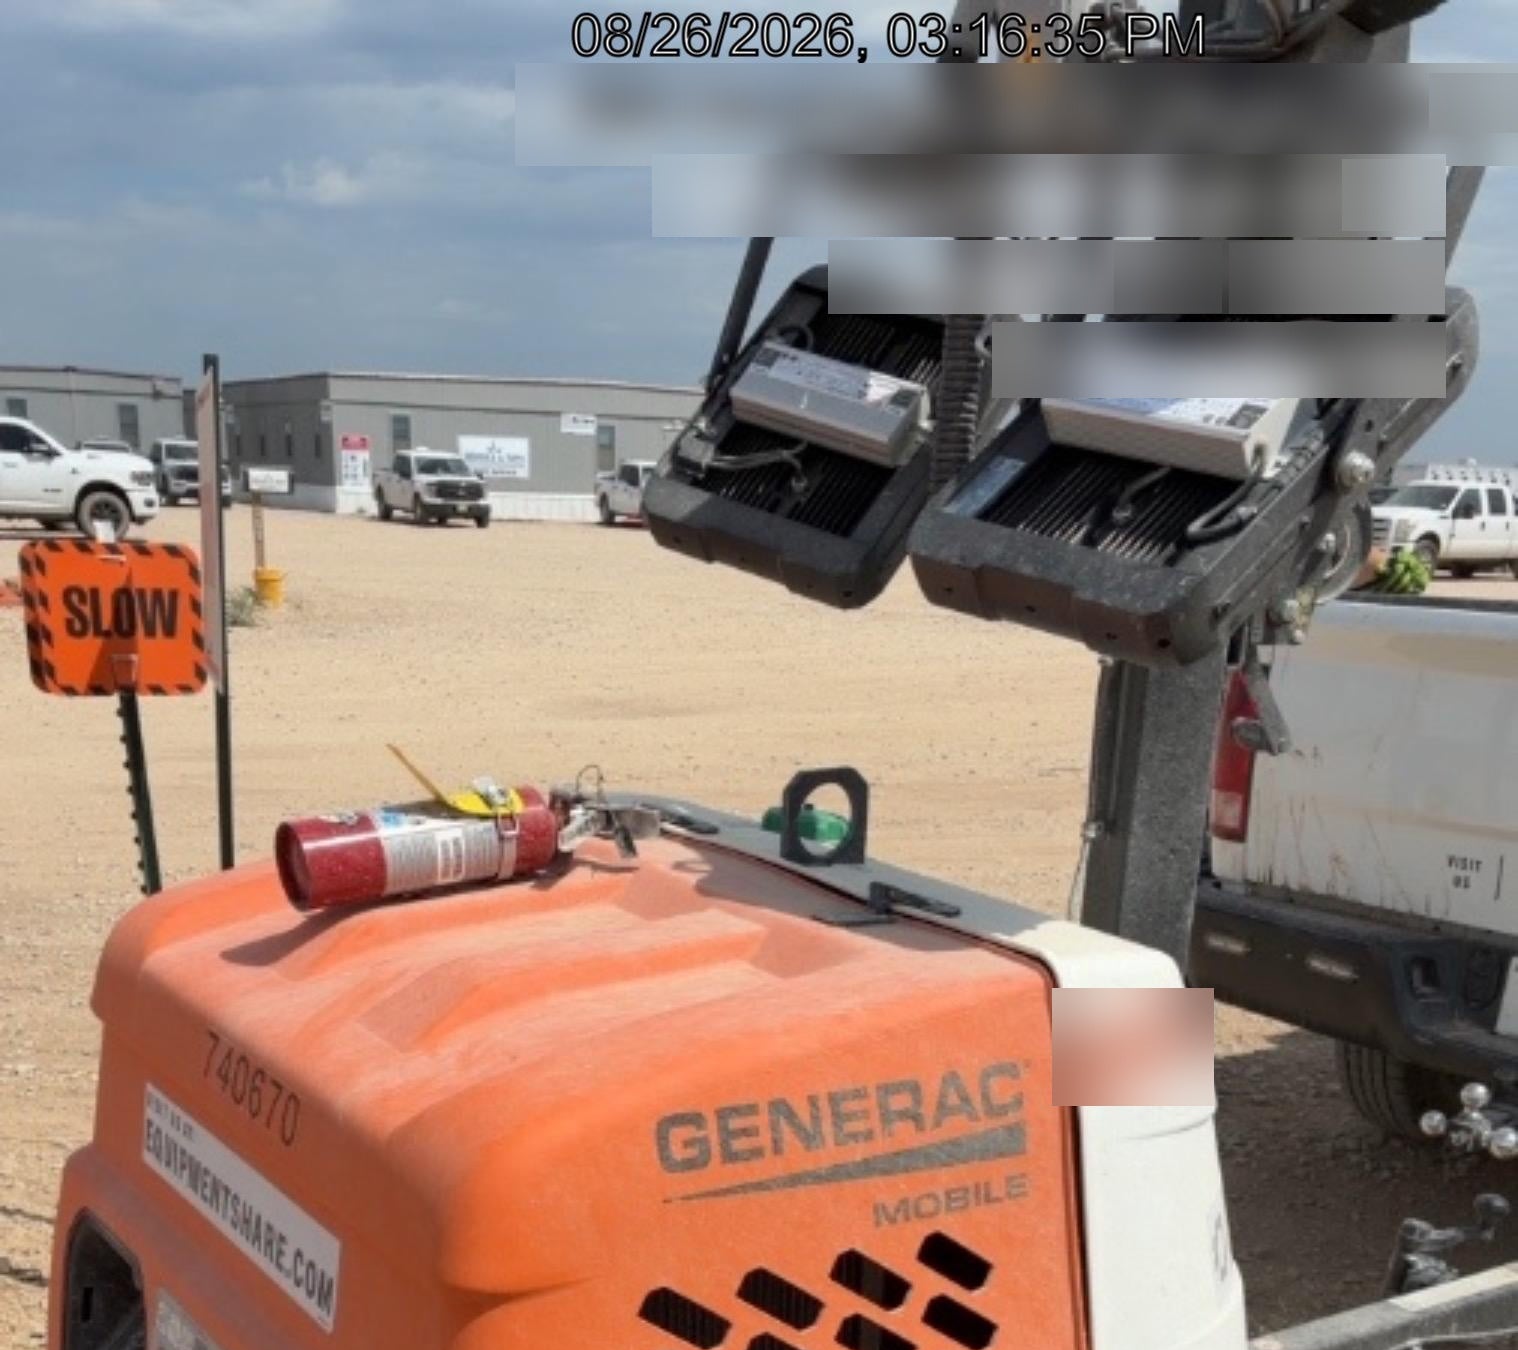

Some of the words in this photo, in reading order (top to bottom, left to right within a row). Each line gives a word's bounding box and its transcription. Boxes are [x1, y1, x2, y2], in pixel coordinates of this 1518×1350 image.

[63, 586, 179, 638] SLOW
[204, 1031, 300, 1147] 740670
[655, 1061, 1025, 1174] GENERAC
[146, 1118, 334, 1316] EQUIPMENTSHARE.COM
[872, 1174, 1030, 1228] MOBILE
